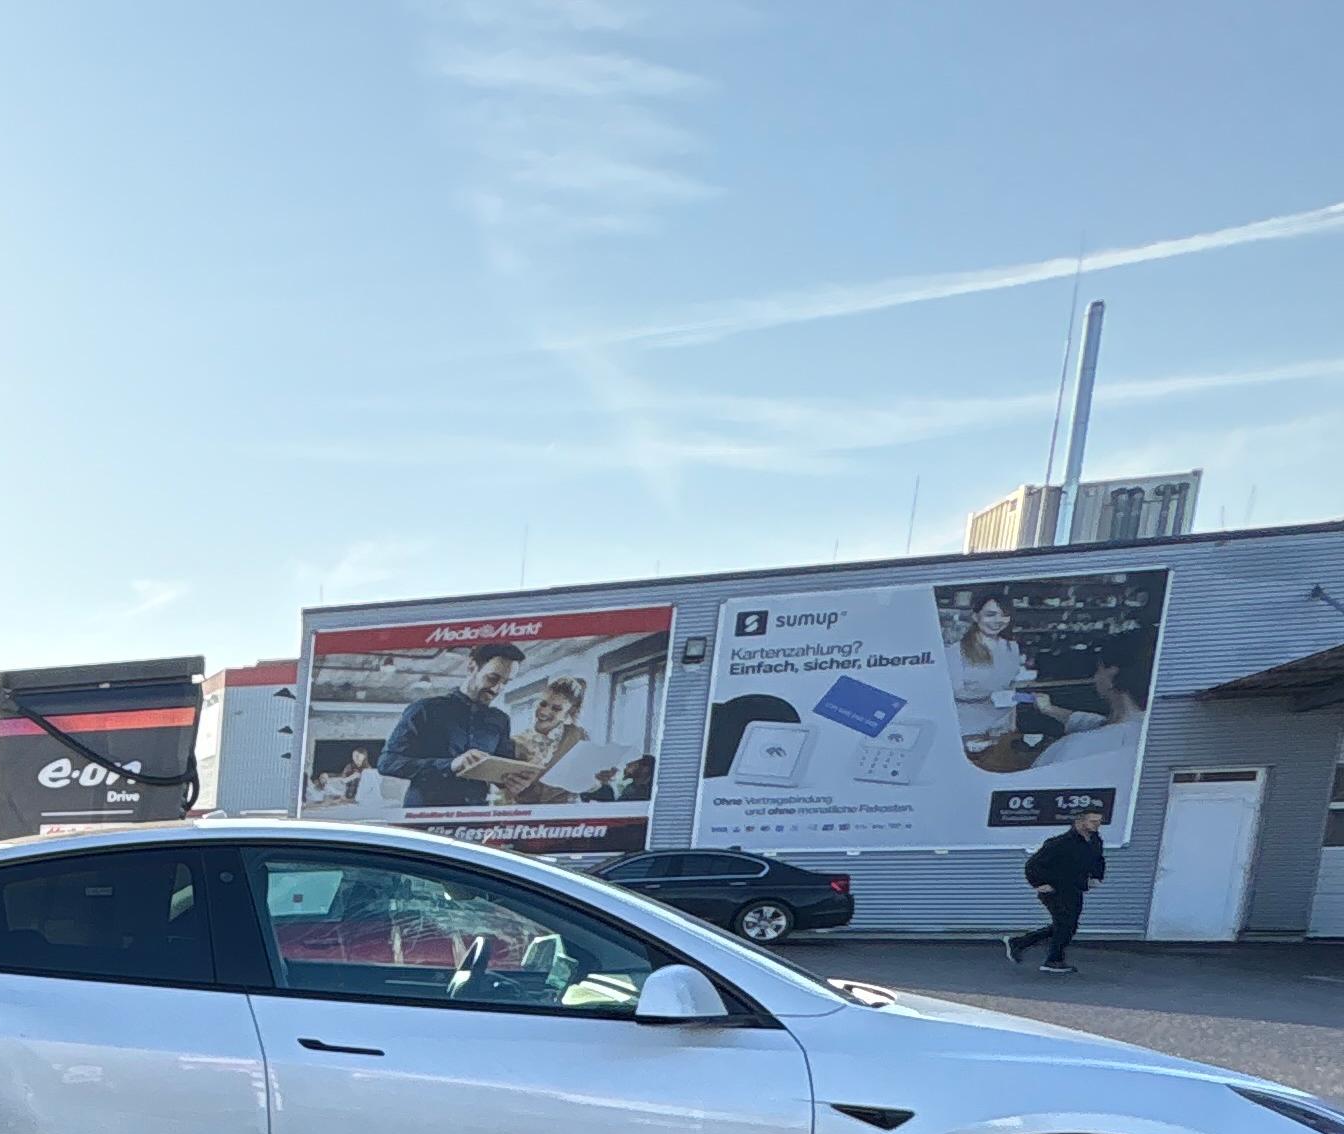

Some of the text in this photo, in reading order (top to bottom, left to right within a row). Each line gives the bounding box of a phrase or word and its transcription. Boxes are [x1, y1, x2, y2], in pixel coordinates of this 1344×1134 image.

[730, 640, 864, 661] Kartenzahlung?
[729, 651, 936, 676] Einfach, sicher, überall.
[106, 789, 141, 803] Drive
[454, 823, 608, 843] Geschäftskunden
